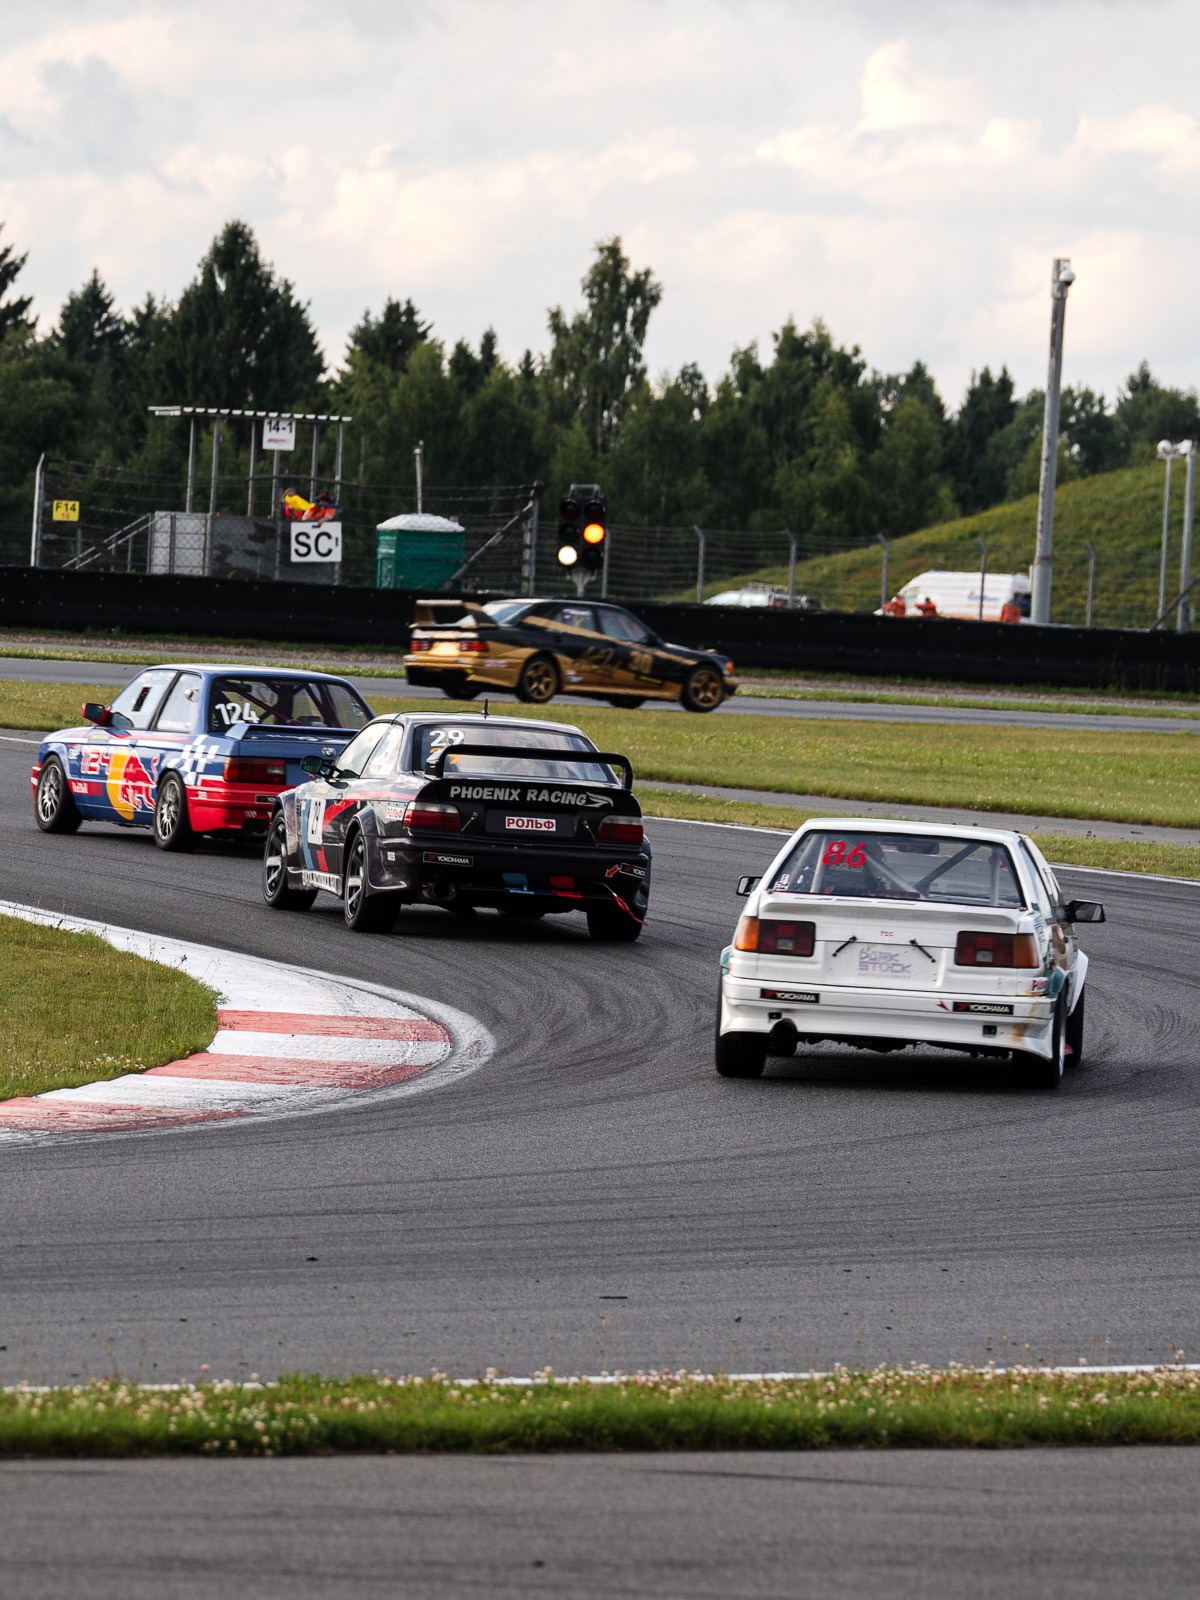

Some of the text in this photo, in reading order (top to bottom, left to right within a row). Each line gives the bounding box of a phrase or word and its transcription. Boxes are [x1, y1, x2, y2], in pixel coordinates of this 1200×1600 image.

[267, 421, 293, 433] 14-1
[55, 502, 76, 512] F14
[294, 531, 332, 557] SC
[215, 702, 260, 725] 124
[429, 730, 465, 747] 29
[450, 785, 587, 806] PHOENIX RACING
[506, 818, 555, 830] РОЛЬФ
[437, 855, 470, 864] YOKOHAMA
[822, 841, 867, 867] 86
[859, 948, 900, 962] DARK
[859, 960, 912, 974] STOCK
[775, 992, 816, 1001] YOKOHAMA
[968, 1004, 1010, 1013] YOKOHAMA
